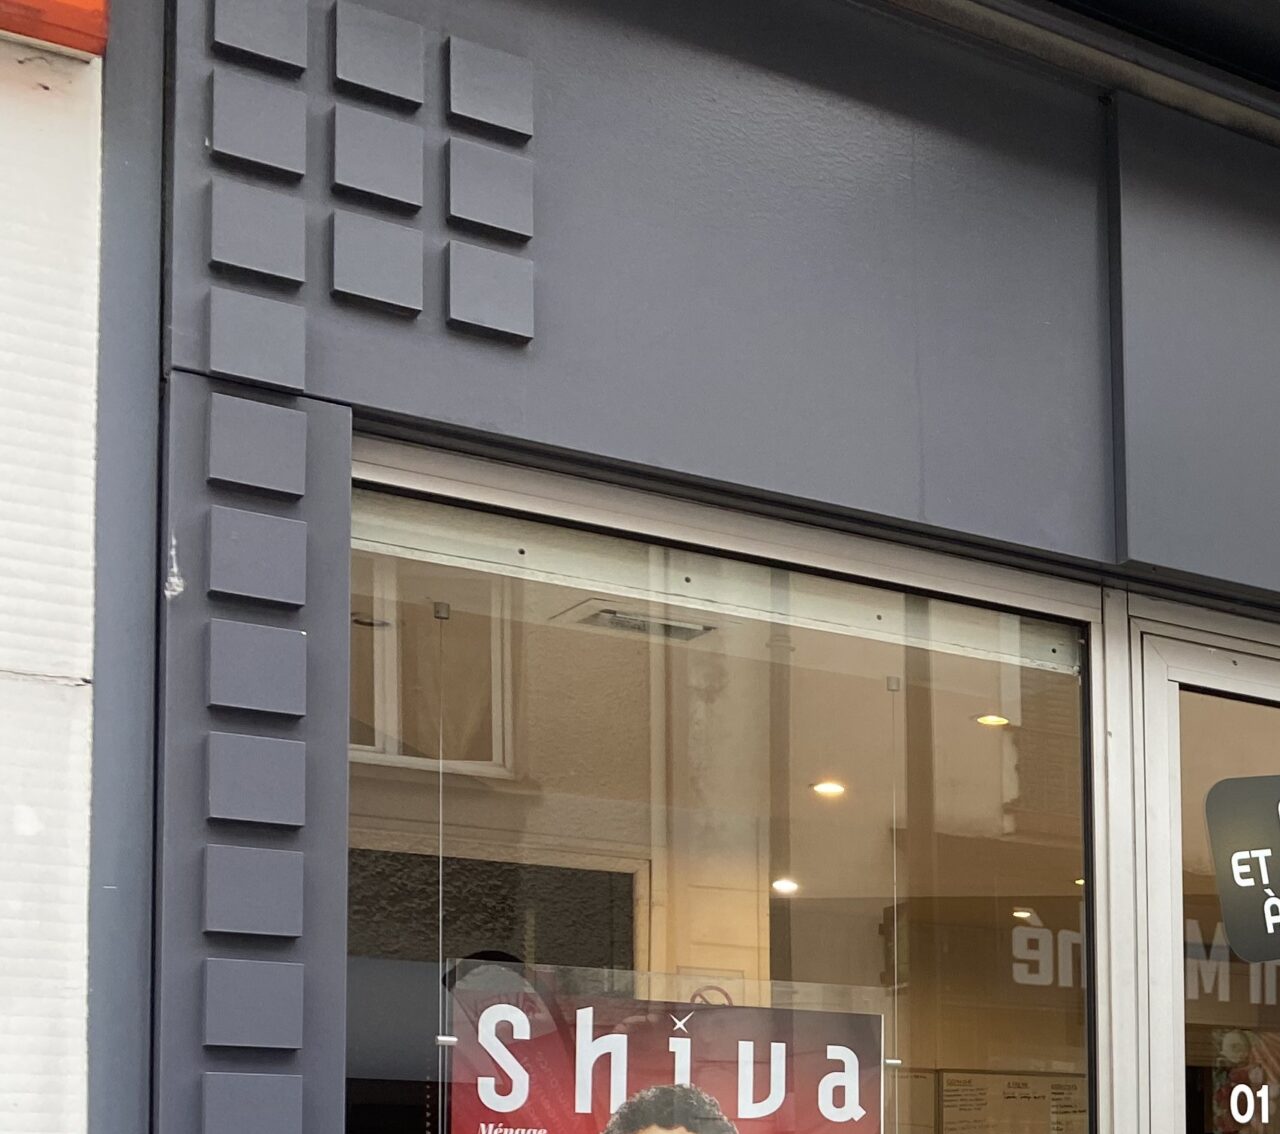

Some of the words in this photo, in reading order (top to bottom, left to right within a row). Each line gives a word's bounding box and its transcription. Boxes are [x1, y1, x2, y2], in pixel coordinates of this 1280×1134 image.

[1231, 848, 1272, 887] ET
[477, 1003, 867, 1122] Shiva
[1230, 1084, 1270, 1124] 01
